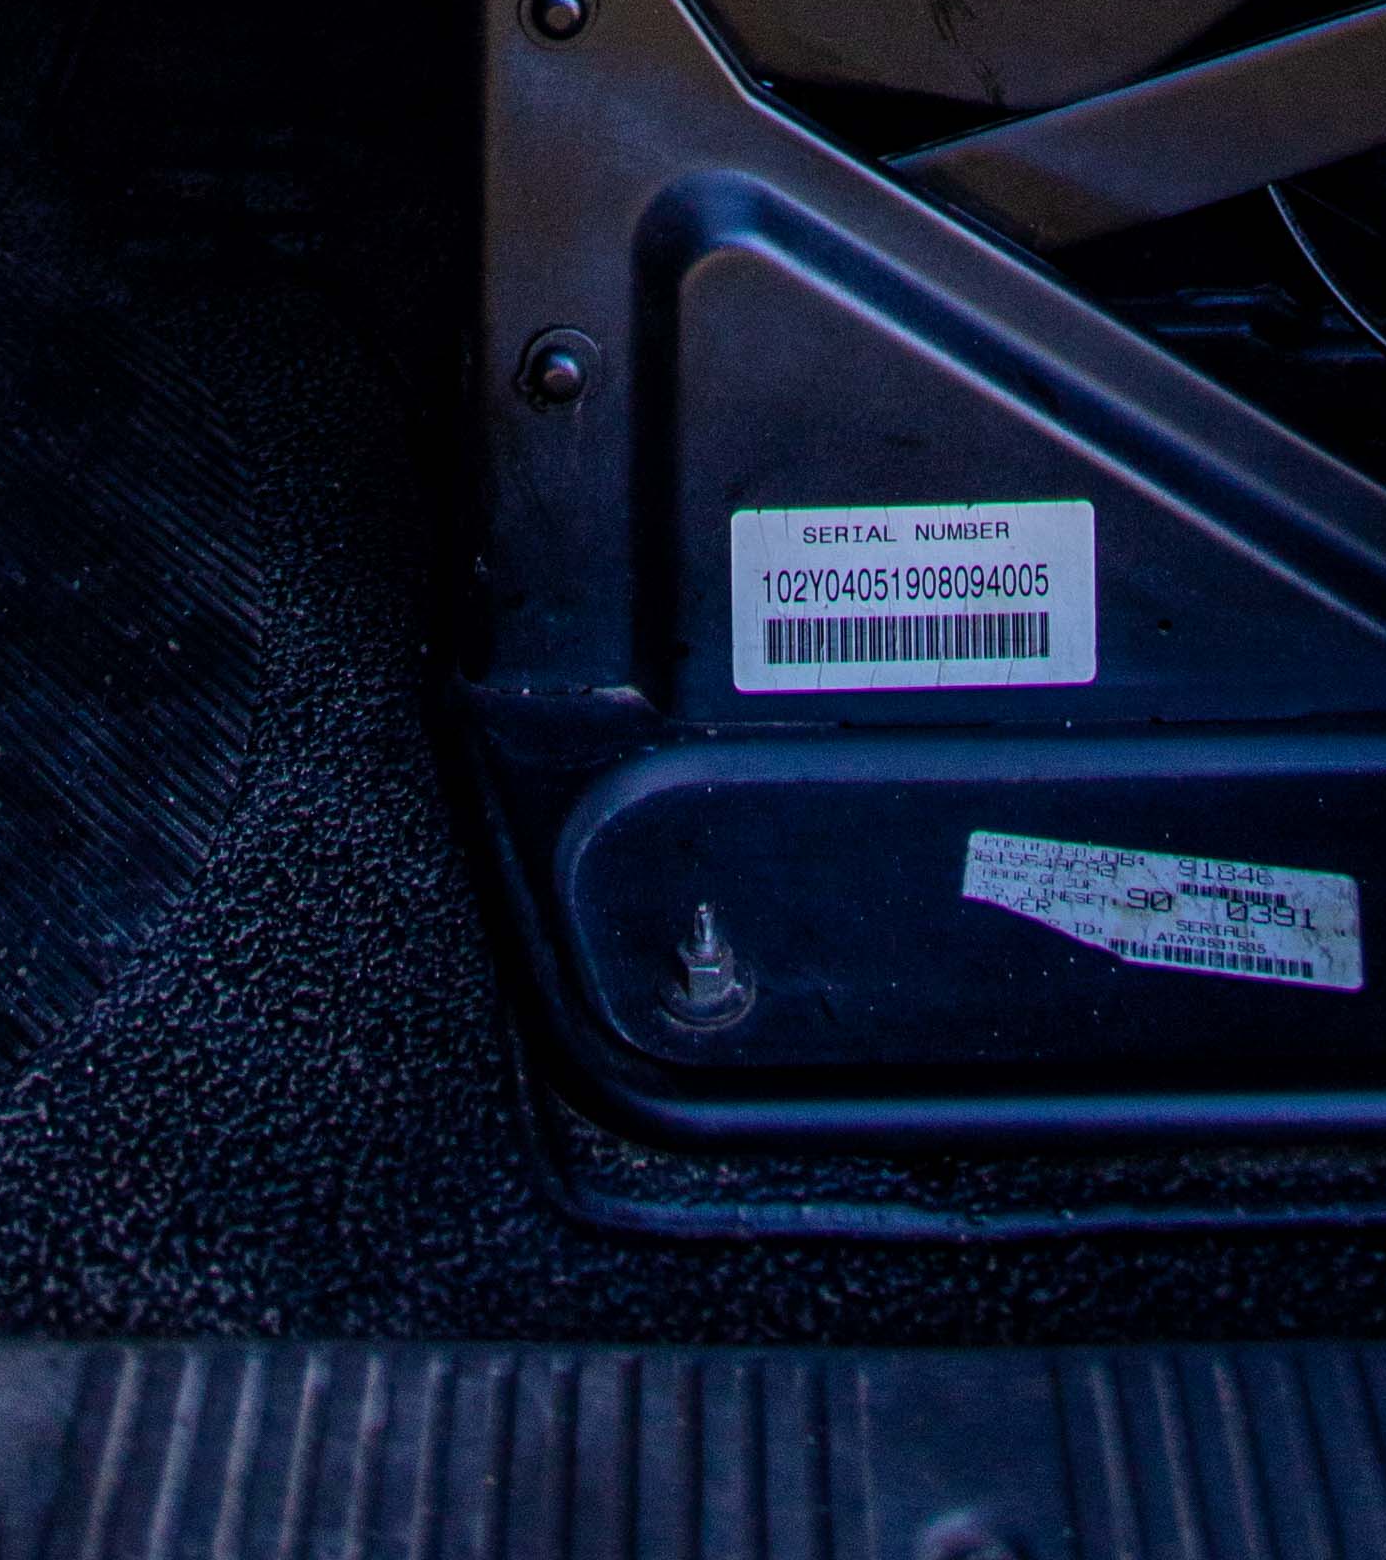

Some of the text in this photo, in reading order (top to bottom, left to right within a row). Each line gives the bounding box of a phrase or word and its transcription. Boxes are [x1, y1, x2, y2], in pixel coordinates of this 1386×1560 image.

[802, 521, 1011, 544] SERIAL NUMBER
[761, 563, 1050, 604] 102Y04051908094005
[1176, 856, 1276, 888] 91846
[1225, 900, 1317, 932] 0391
